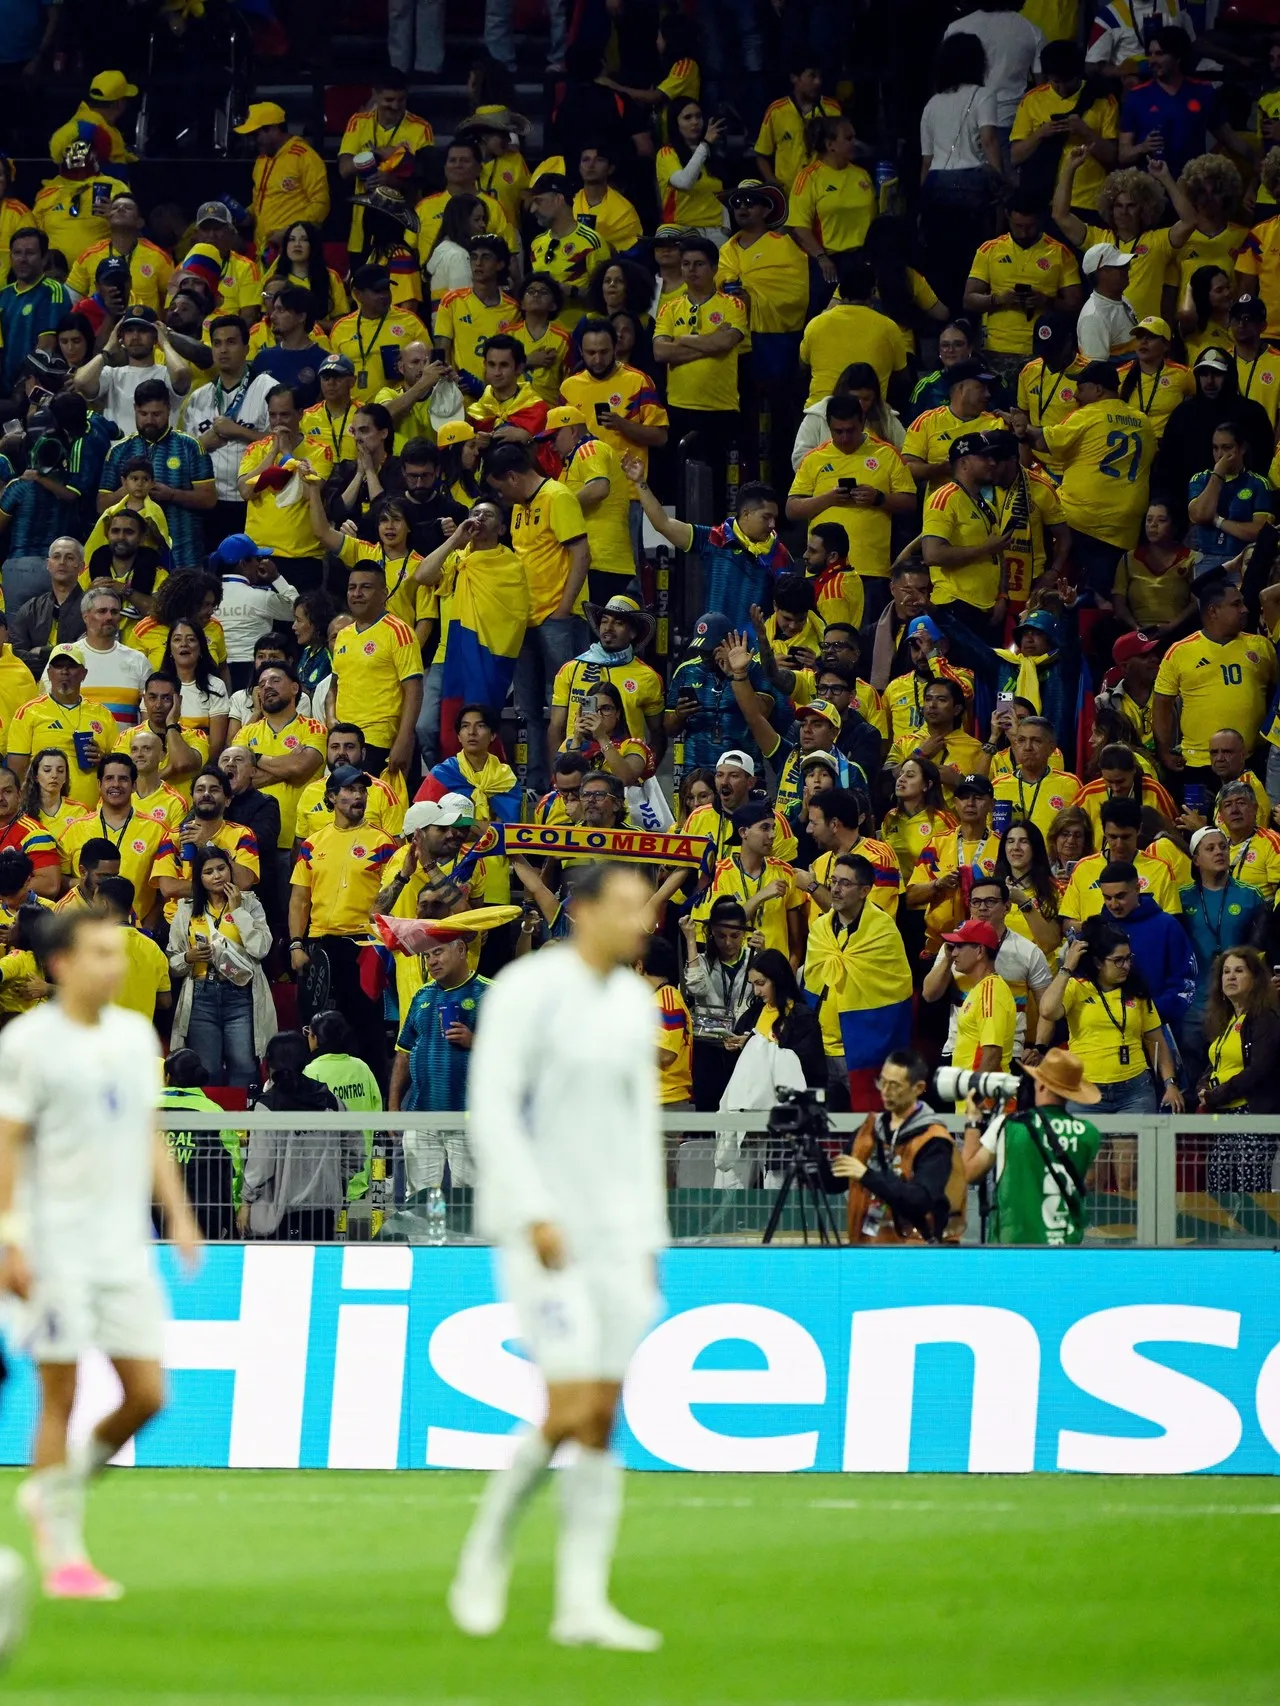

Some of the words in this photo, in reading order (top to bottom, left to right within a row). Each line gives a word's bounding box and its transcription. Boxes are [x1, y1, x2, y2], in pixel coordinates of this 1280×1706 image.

[1116, 414, 1142, 428] MUÑOZ
[1100, 430, 1141, 481] 21
[215, 604, 256, 618] OLICÍA
[1220, 663, 1242, 686] 10
[640, 799, 660, 829] VIS
[516, 828, 694, 856] COLOMBIA
[333, 1082, 366, 1100] CONTROL
[160, 1131, 196, 1147] CAL
[166, 1147, 193, 1164] EW
[67, 1246, 1280, 1475] Hisens
